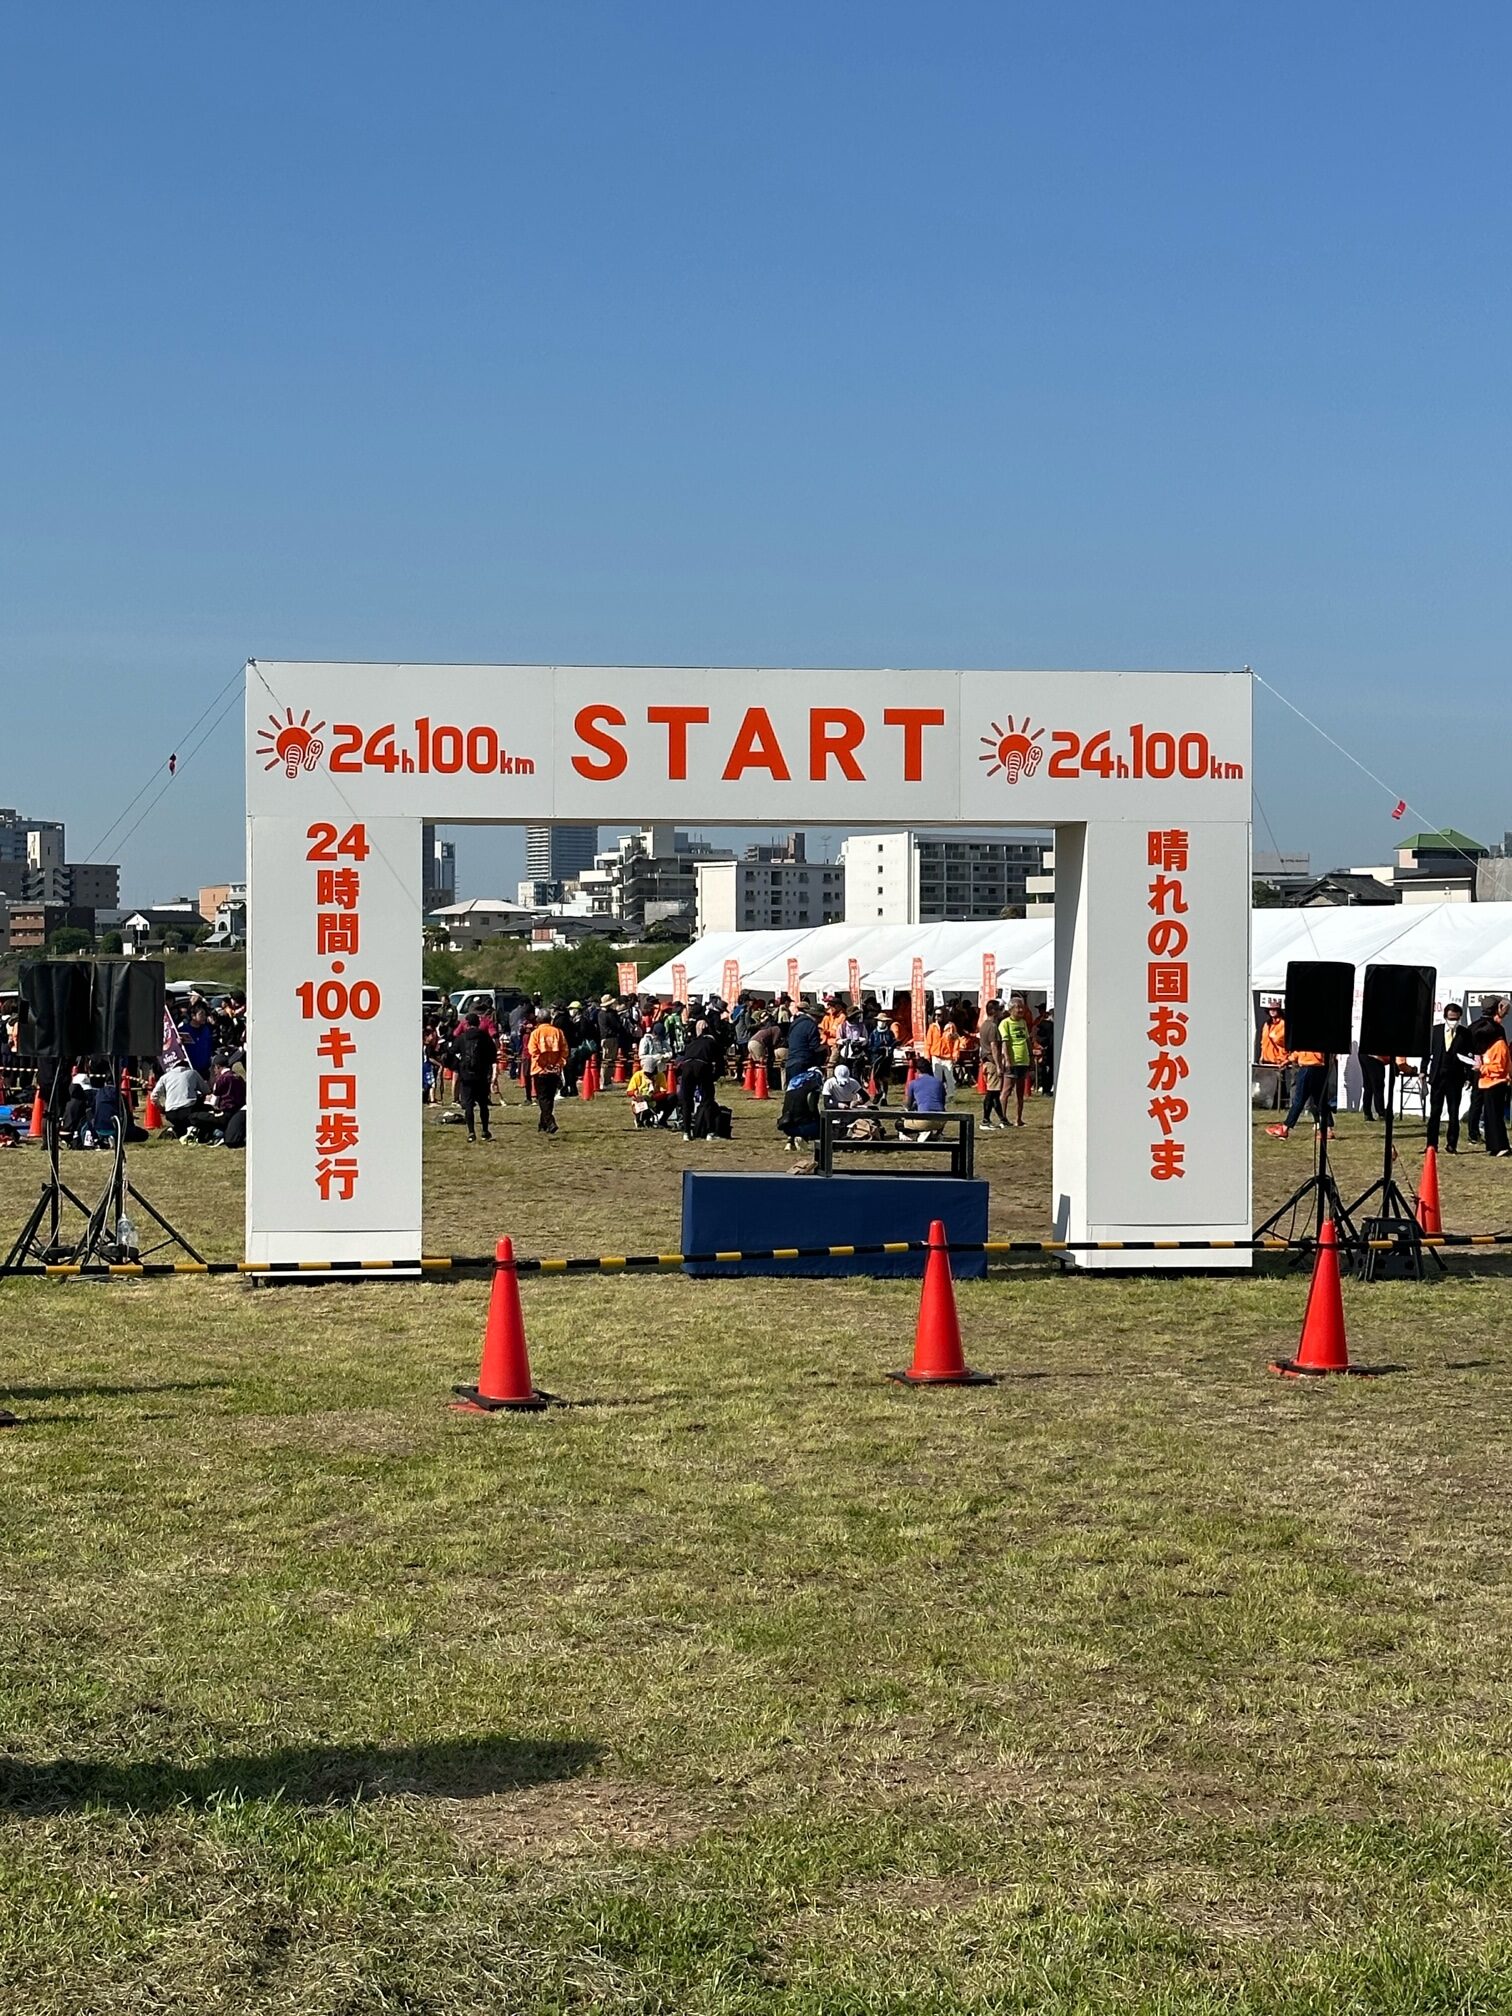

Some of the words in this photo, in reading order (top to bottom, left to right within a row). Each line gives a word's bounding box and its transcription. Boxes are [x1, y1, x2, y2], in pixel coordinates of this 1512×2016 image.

[571, 704, 945, 782] START
[1146, 829, 1189, 1181] 晴れの国おかやま
